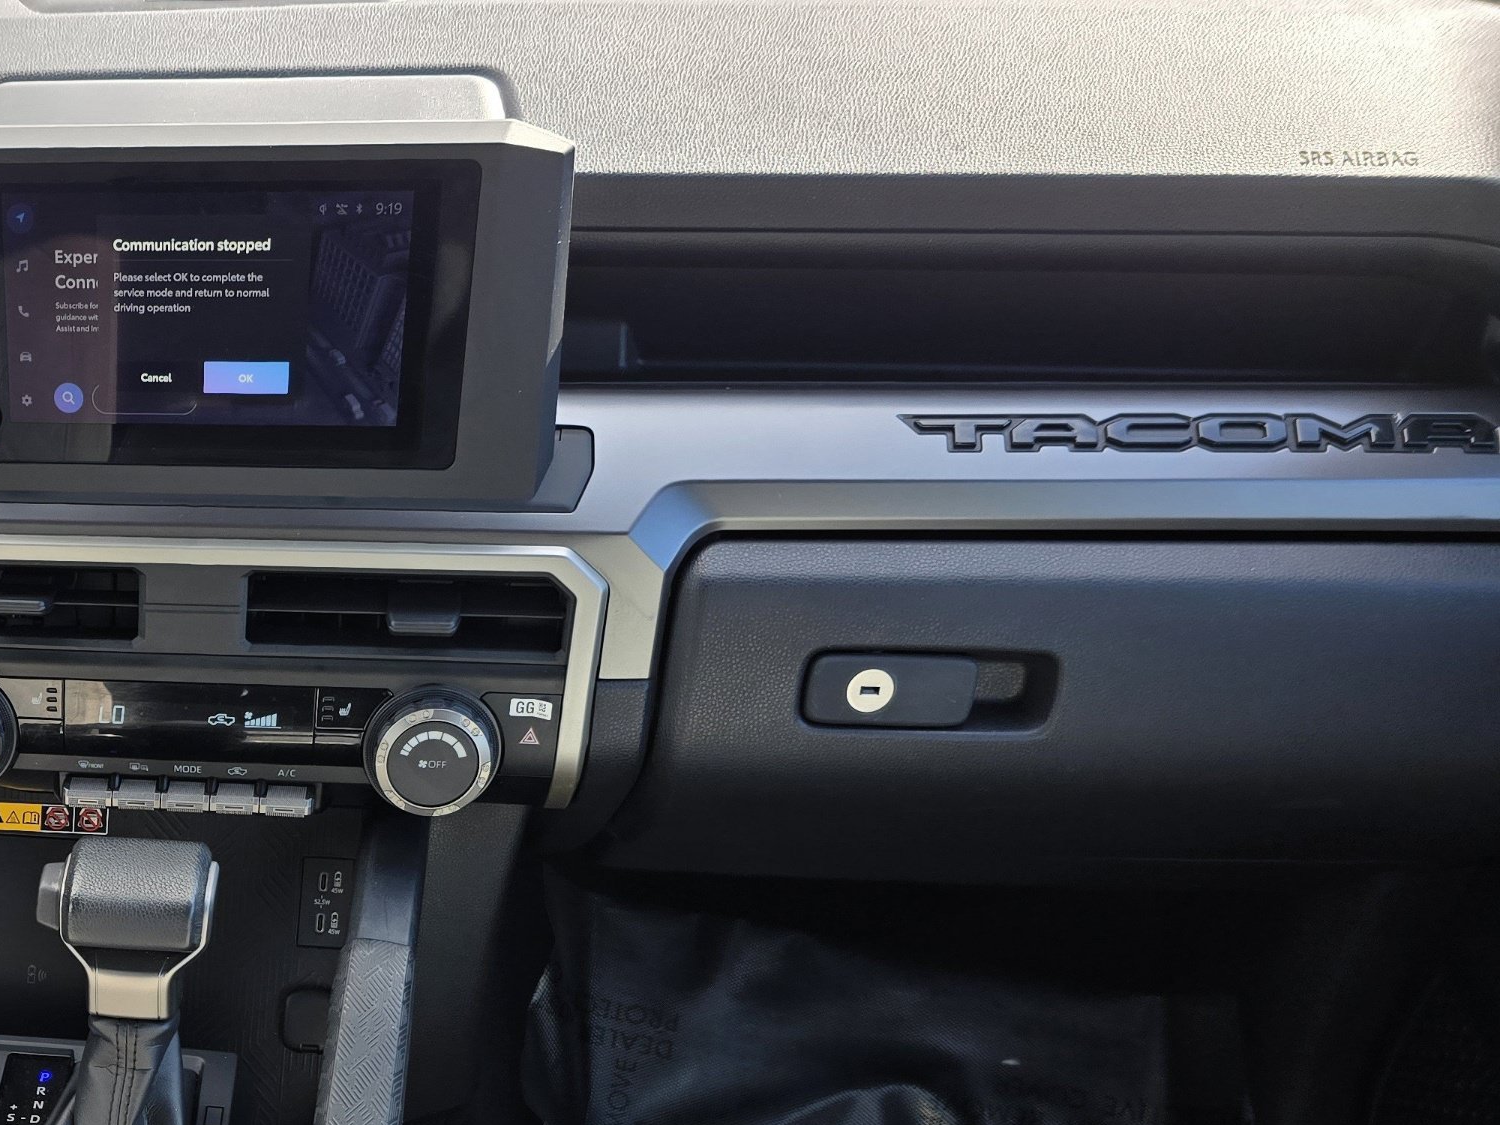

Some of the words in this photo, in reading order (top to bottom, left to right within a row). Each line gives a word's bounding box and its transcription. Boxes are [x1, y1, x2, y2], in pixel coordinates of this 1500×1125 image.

[1299, 151, 1333, 166] SRS
[1342, 151, 1418, 166] AIRBAG
[376, 202, 403, 215] 9:19
[113, 238, 214, 251] Communication
[217, 238, 272, 254] stopped
[113, 273, 143, 282] Please
[145, 273, 172, 282] select
[173, 273, 188, 282] OK
[190, 273, 200, 282] to
[202, 273, 246, 284] complete
[247, 273, 263, 282] the
[113, 288, 145, 297] service
[147, 288, 173, 297] mode
[175, 288, 193, 297] and
[195, 289, 222, 297] return
[225, 289, 235, 297] to
[237, 288, 270, 297] normal
[56, 302, 88, 310] Subscribe
[113, 303, 145, 315] driving
[147, 303, 191, 314] operation
[56, 314, 87, 322] guidance
[141, 373, 172, 383] Cancel
[238, 374, 254, 383] OK
[896, 412, 1499, 454] TACOMA
[516, 701, 535, 714] GG
[100, 705, 125, 725] LO
[174, 765, 202, 774] MODE
[428, 761, 448, 769] OFF
[278, 769, 296, 777] A/C
[40, 1072, 50, 1082] P
[37, 1087, 46, 1096] R
[33, 1101, 44, 1110] N
[7, 1113, 16, 1122] S
[30, 1115, 41, 1124] D
